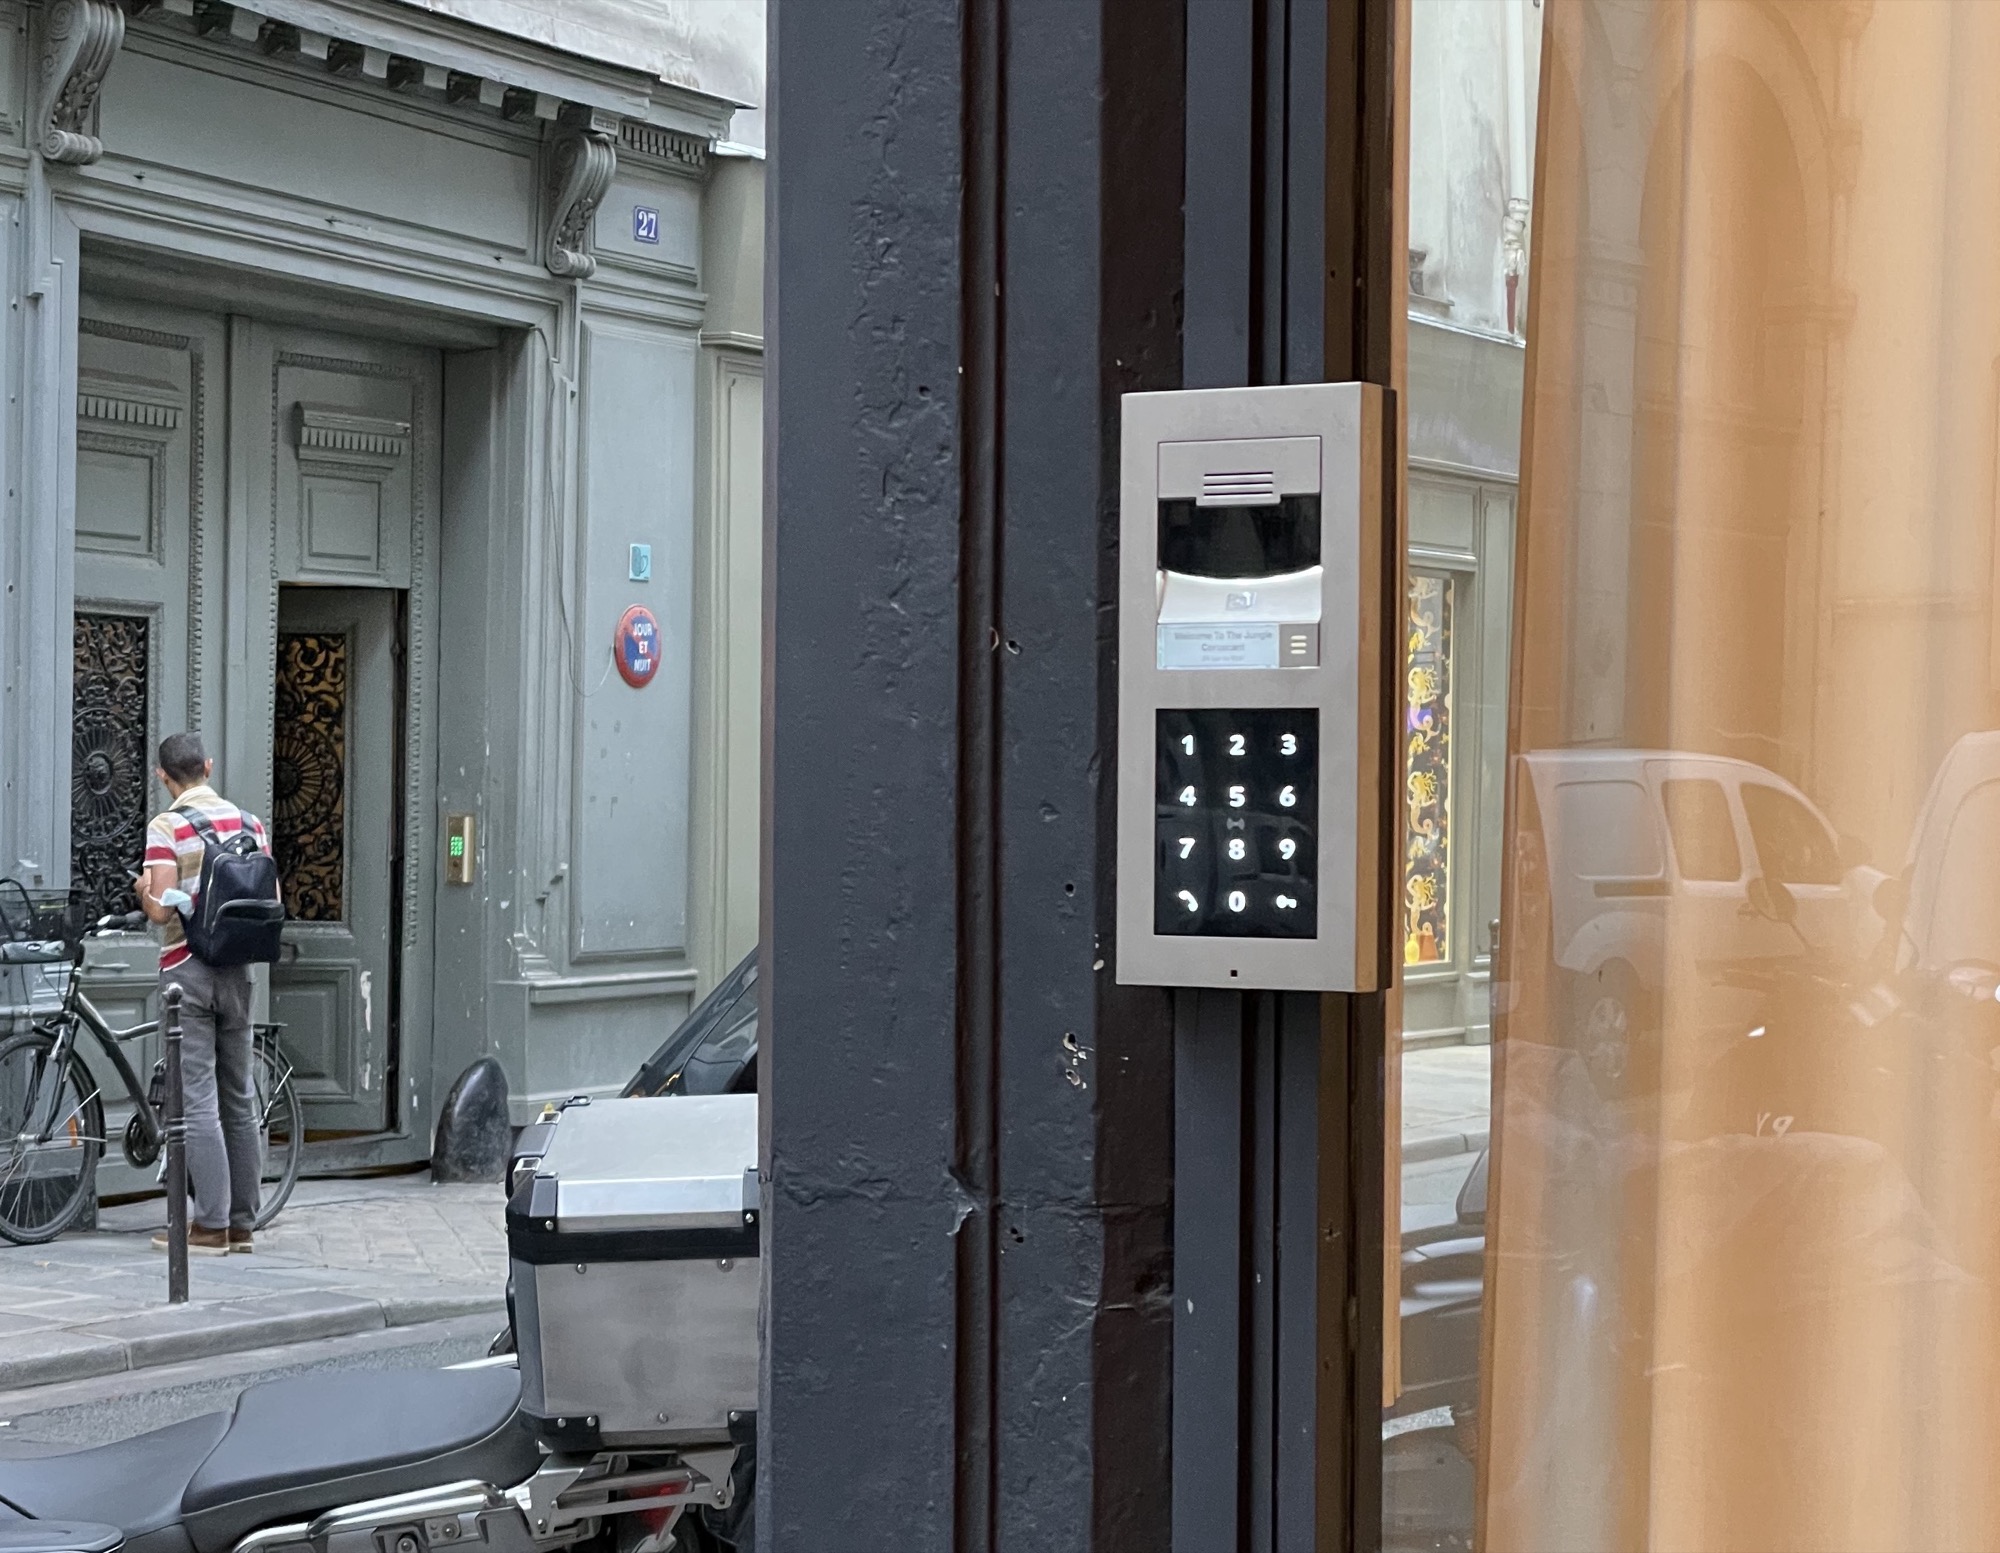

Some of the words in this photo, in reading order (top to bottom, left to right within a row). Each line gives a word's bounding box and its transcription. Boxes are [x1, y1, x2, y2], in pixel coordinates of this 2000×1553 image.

[638, 211, 656, 238] 27
[633, 623, 653, 637] JOUR
[638, 641, 648, 654] ET
[633, 658, 651, 672] NUIT
[1181, 734, 1194, 756] 1
[1229, 734, 1246, 756] 2
[1280, 733, 1297, 755] 3
[1179, 785, 1197, 807] 4
[1229, 785, 1246, 808] 5
[1279, 785, 1296, 807] 6
[1178, 837, 1196, 859] 7
[1228, 838, 1245, 860] 8
[1278, 838, 1296, 860] 9
[1228, 890, 1246, 912] 0
